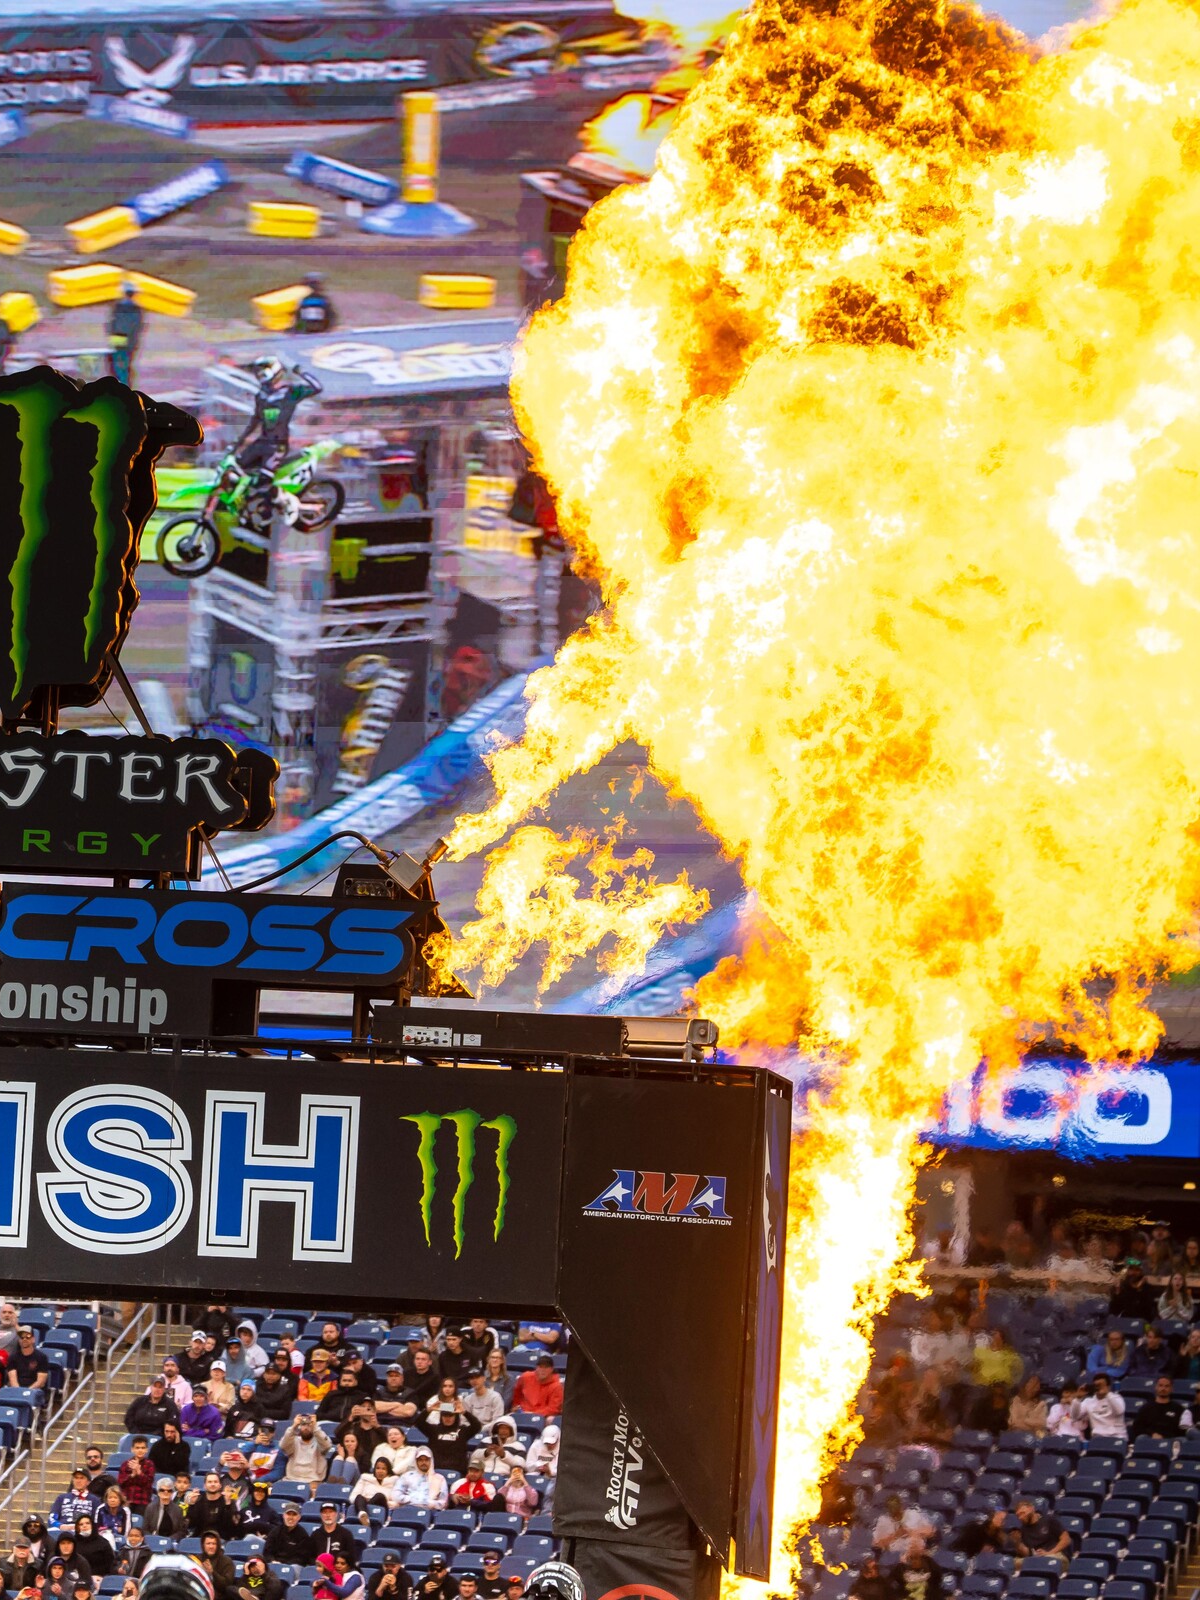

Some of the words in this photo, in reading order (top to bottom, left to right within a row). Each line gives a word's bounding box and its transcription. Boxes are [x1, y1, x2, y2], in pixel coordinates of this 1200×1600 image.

[581, 1169, 734, 1219] AMA
[582, 1210, 623, 1219] AMERICAN
[623, 1213, 681, 1223] MOTORCYCLIST
[681, 1216, 732, 1226] ASSOCIATION
[613, 1409, 629, 1447] MO
[606, 1447, 625, 1503] ROCKY
